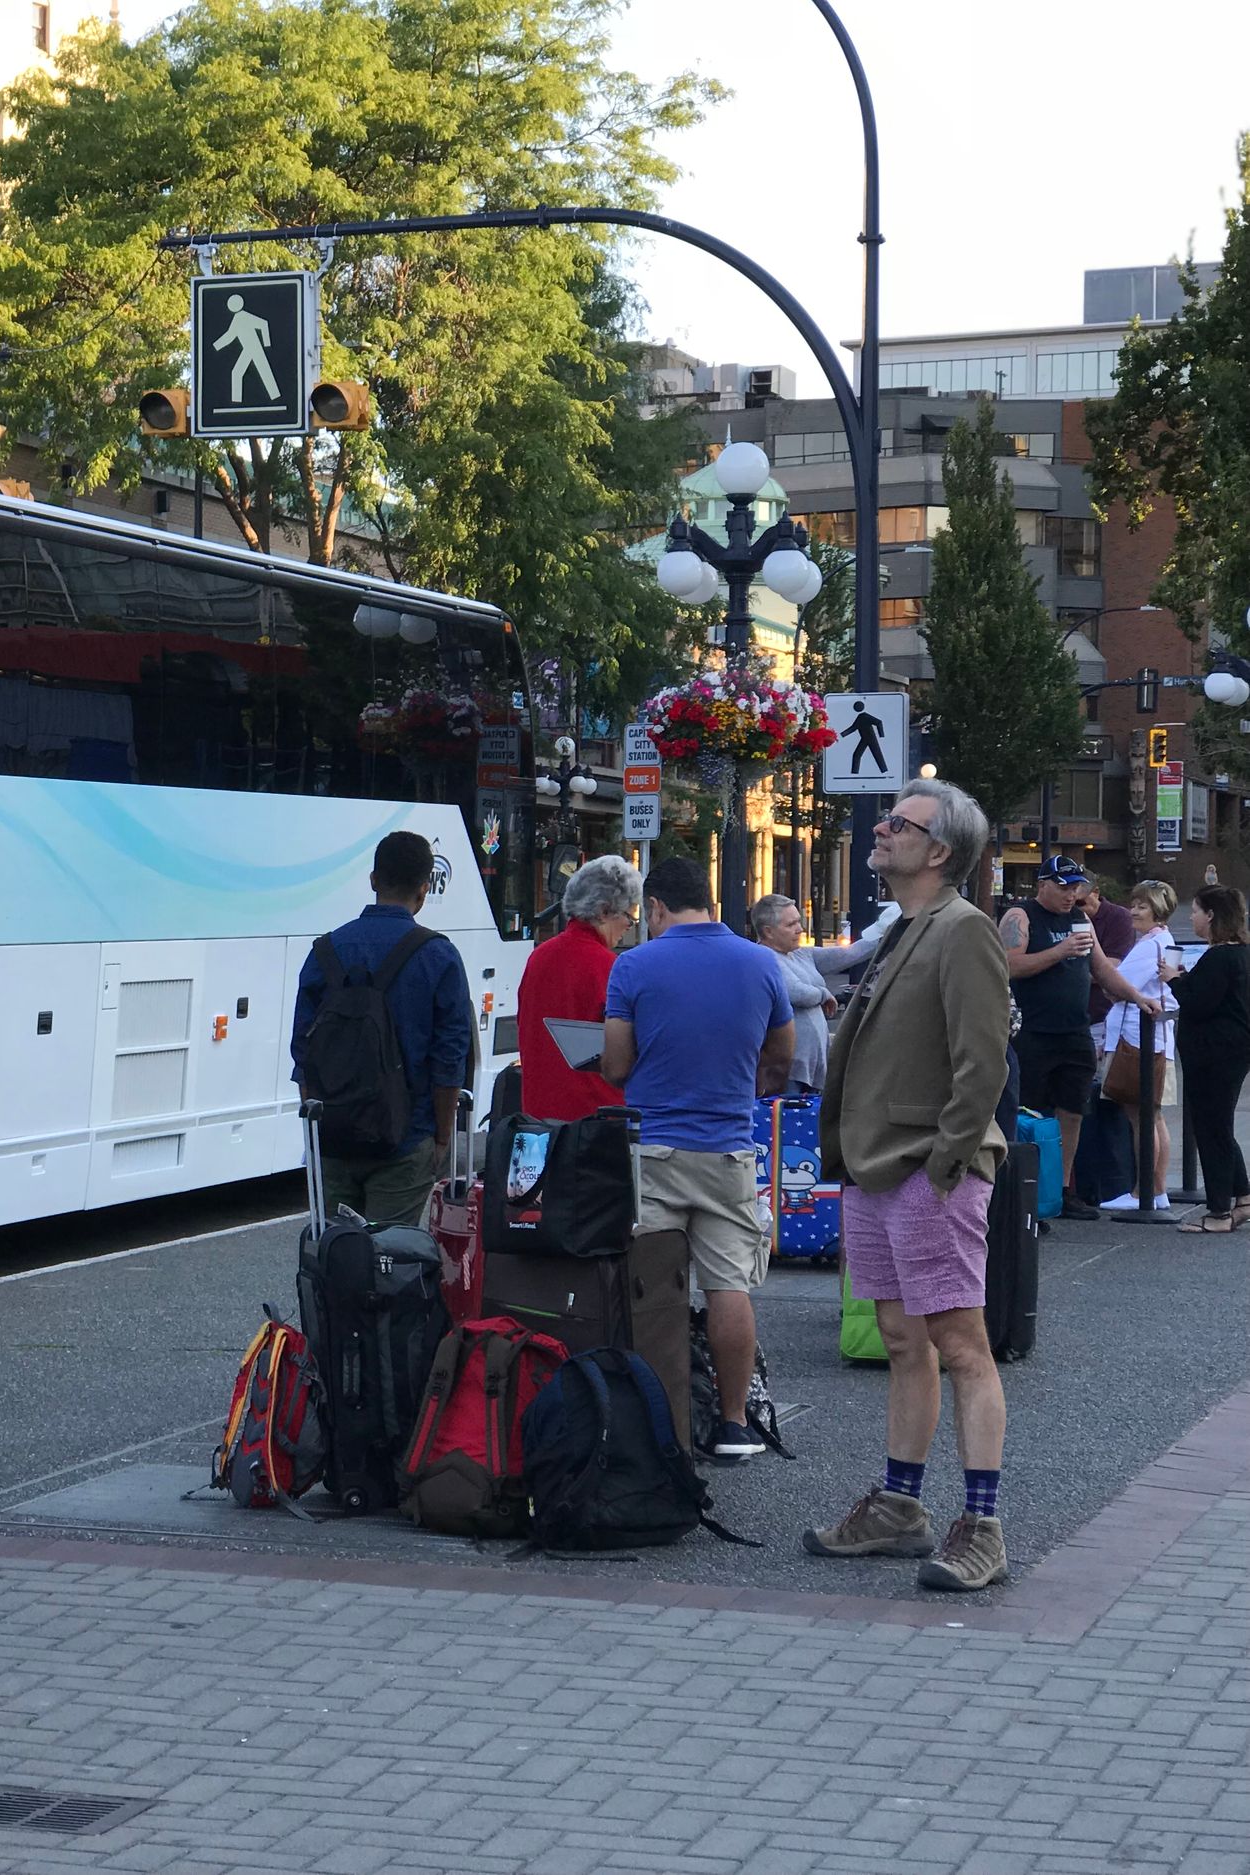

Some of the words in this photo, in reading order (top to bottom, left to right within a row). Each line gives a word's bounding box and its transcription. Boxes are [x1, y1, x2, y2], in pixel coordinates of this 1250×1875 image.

[628, 728, 650, 738] CAPIT
[634, 740, 651, 750] CITY
[628, 751, 658, 761] STATION
[629, 775, 649, 785] ZONE
[651, 775, 656, 785] 1
[629, 805, 654, 815] BUSES
[631, 819, 651, 829] ONLY
